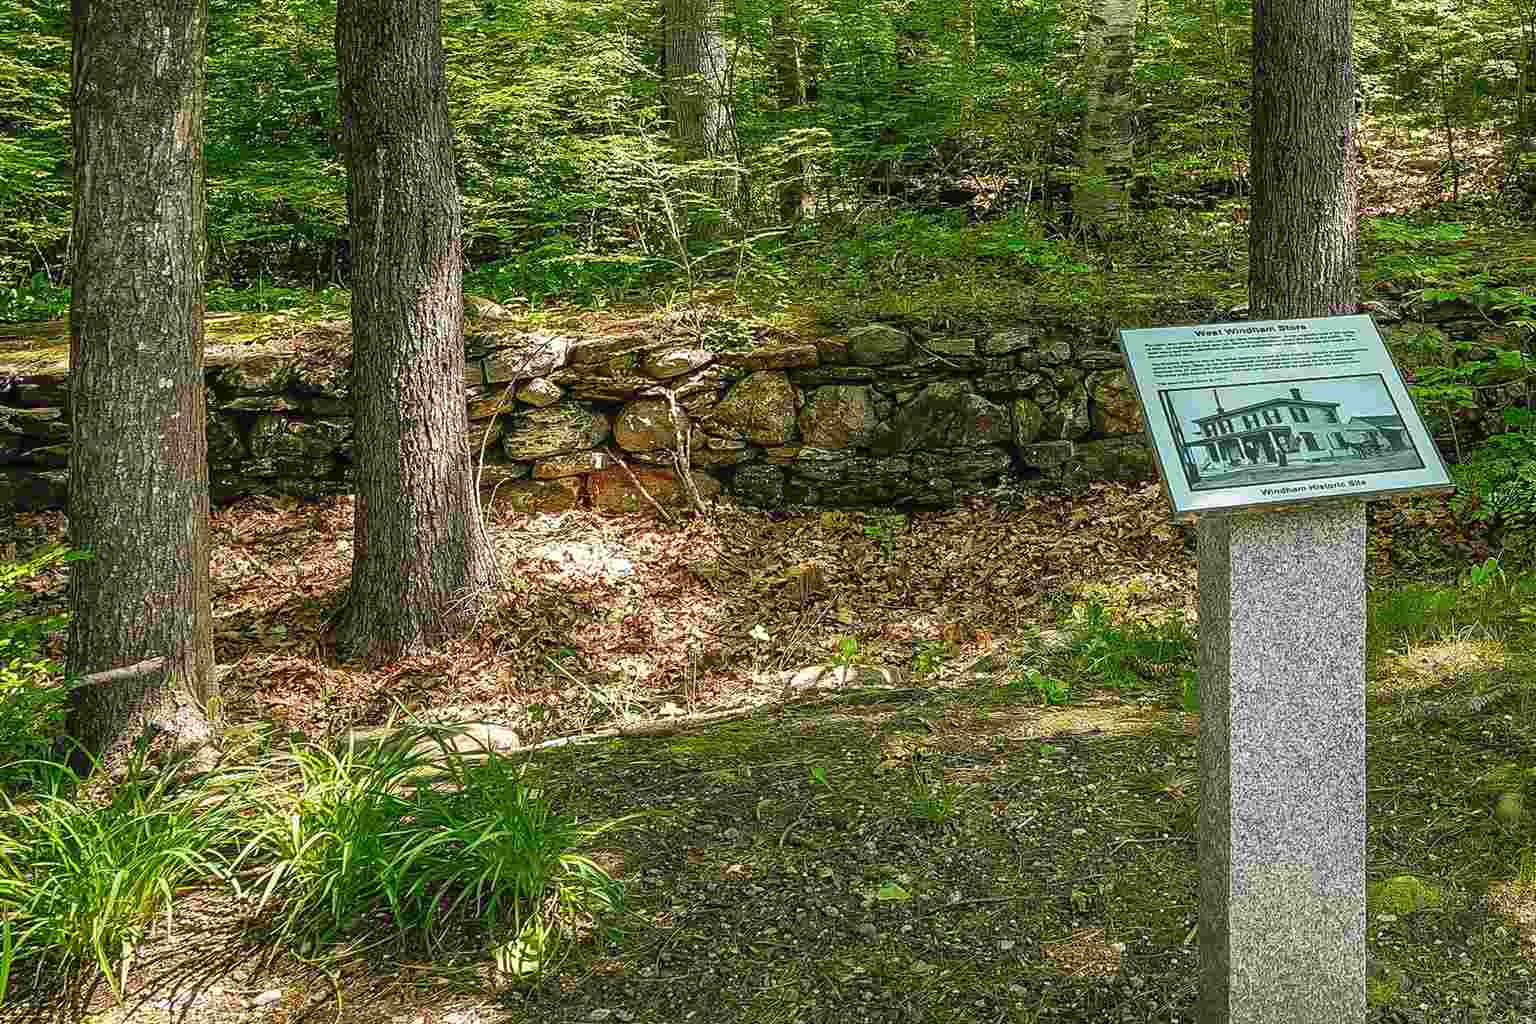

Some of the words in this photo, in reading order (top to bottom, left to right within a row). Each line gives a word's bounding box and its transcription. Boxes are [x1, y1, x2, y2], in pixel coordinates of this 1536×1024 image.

[1194, 327, 1222, 337] West
[1223, 325, 1276, 336] Windham
[1278, 323, 1307, 333] Store
[1259, 486, 1306, 496] Windham
[1308, 480, 1346, 492] Historic
[1347, 478, 1367, 488] Site
